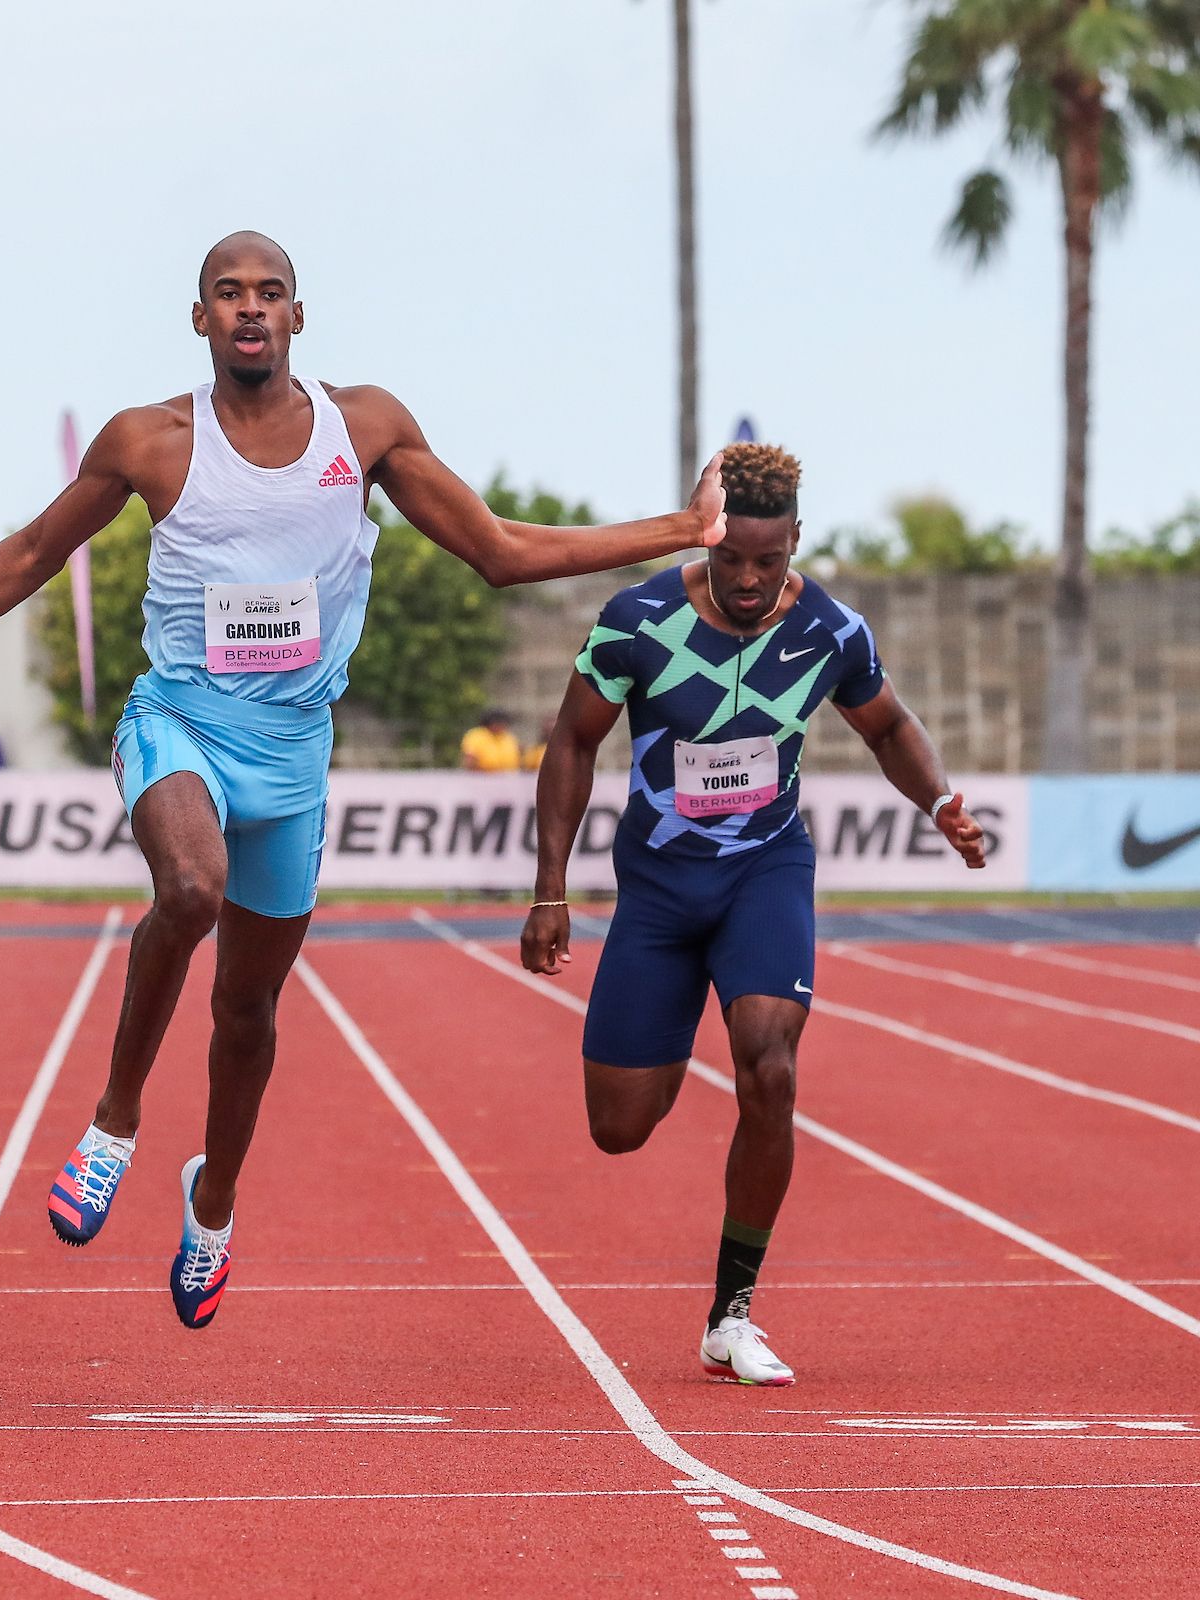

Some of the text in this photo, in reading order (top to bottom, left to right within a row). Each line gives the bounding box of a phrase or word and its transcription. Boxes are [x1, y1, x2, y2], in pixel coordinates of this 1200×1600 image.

[318, 474, 358, 487] adidas
[245, 606, 281, 614] GAMES
[225, 620, 301, 639] GARDINER
[225, 647, 303, 660] BERMUDA
[709, 759, 741, 769] GAMES
[702, 773, 750, 790] YOUNG
[690, 793, 762, 808] BERMUDA
